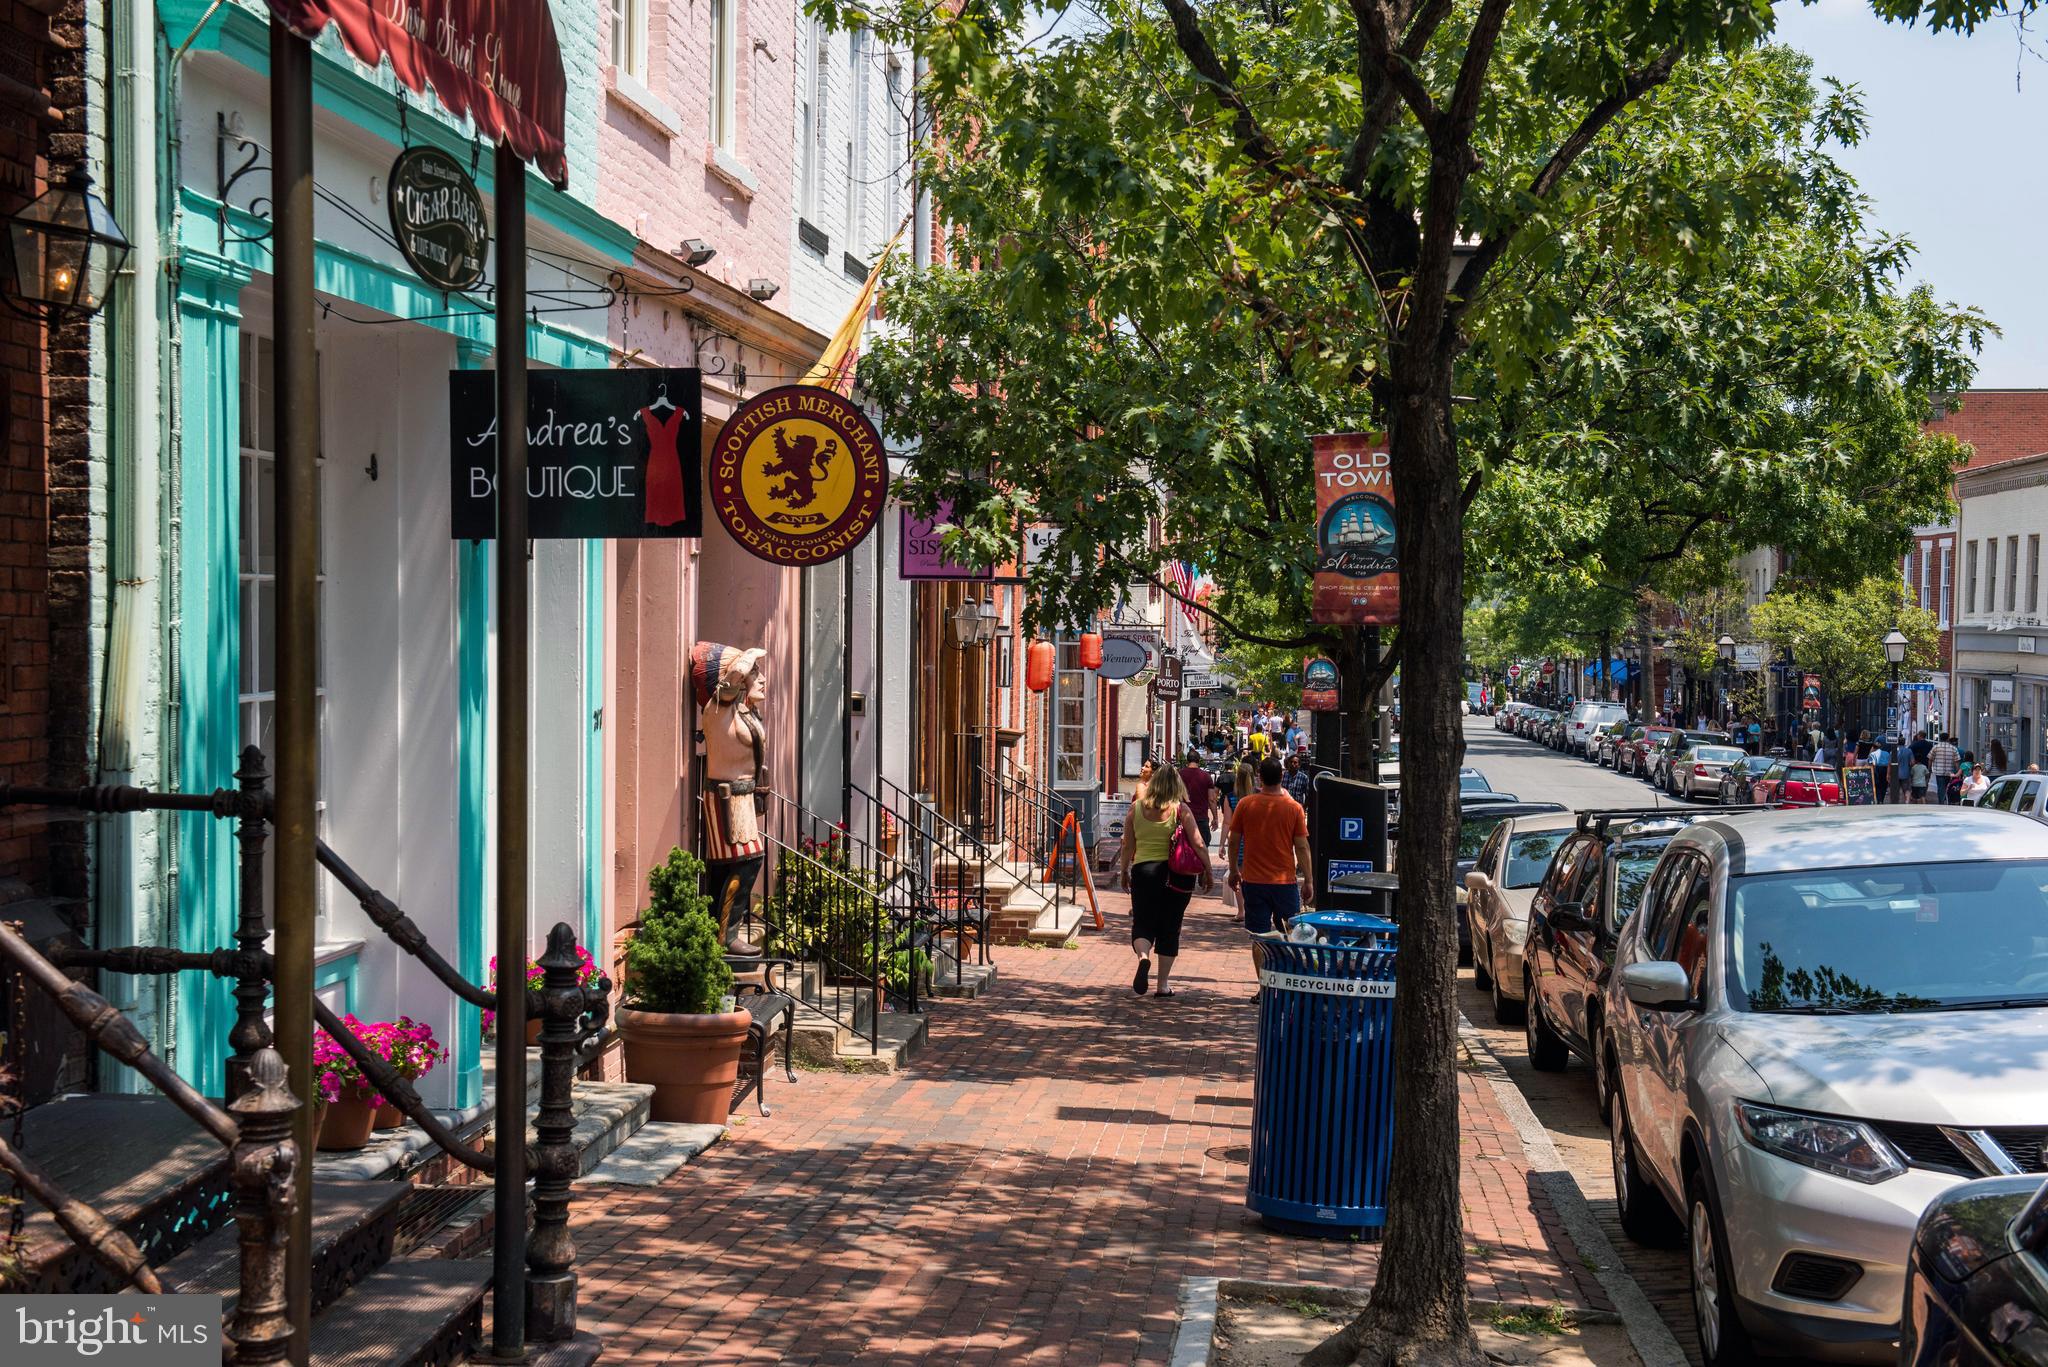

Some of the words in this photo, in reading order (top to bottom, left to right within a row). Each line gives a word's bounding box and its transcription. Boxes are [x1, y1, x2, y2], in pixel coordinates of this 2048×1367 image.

[406, 185, 449, 224] CIGAR
[452, 187, 478, 242] BAR
[416, 236, 429, 258] LIVE
[430, 241, 448, 266] MUSIC
[467, 409, 632, 446] Adrea's
[720, 397, 791, 479] SCOTTISH
[798, 396, 880, 484] MERCHANT
[1333, 452, 1391, 469] OLD
[470, 465, 635, 500] BUTIQUE
[777, 514, 818, 524] AND
[723, 500, 873, 560] TOBACCONIST
[757, 528, 787, 545] John
[791, 530, 836, 546] Crouch
[1322, 552, 1398, 570] Alexandria
[1132, 634, 1155, 642] SPACE
[1166, 668, 1172, 677] IL
[1156, 678, 1180, 688] PORTO
[1344, 820, 1358, 838] P
[1286, 978, 1354, 992] RECYCLING
[1360, 985, 1390, 994] ONLY
